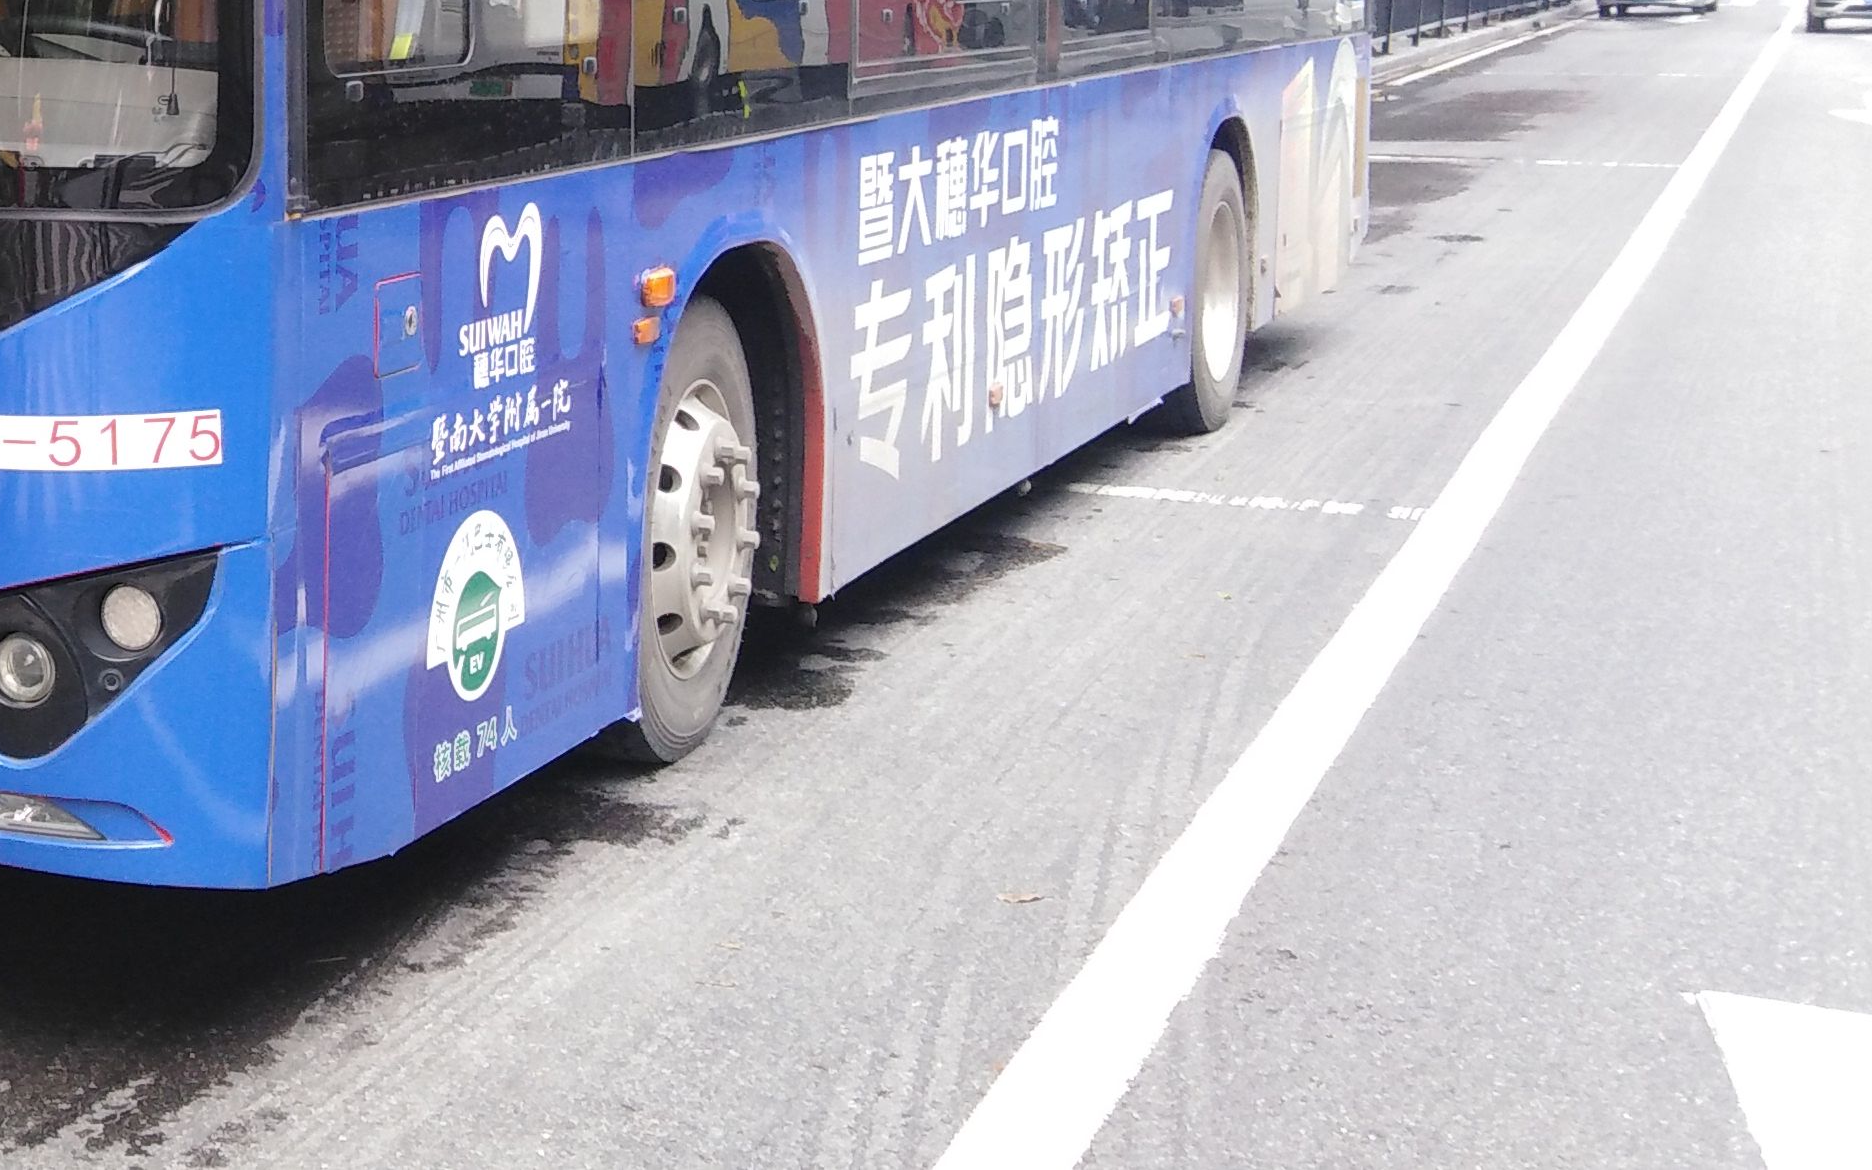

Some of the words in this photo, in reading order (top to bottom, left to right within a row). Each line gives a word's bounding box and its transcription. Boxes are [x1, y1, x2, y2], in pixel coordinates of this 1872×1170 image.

[850, 189, 1175, 480] 专利隐形矫正
[431, 378, 572, 466] 暨南大学附属一院
[469, 651, 485, 676] EV
[433, 730, 471, 784] 核载
[476, 716, 498, 759] 74
[500, 705, 518, 747] 人
